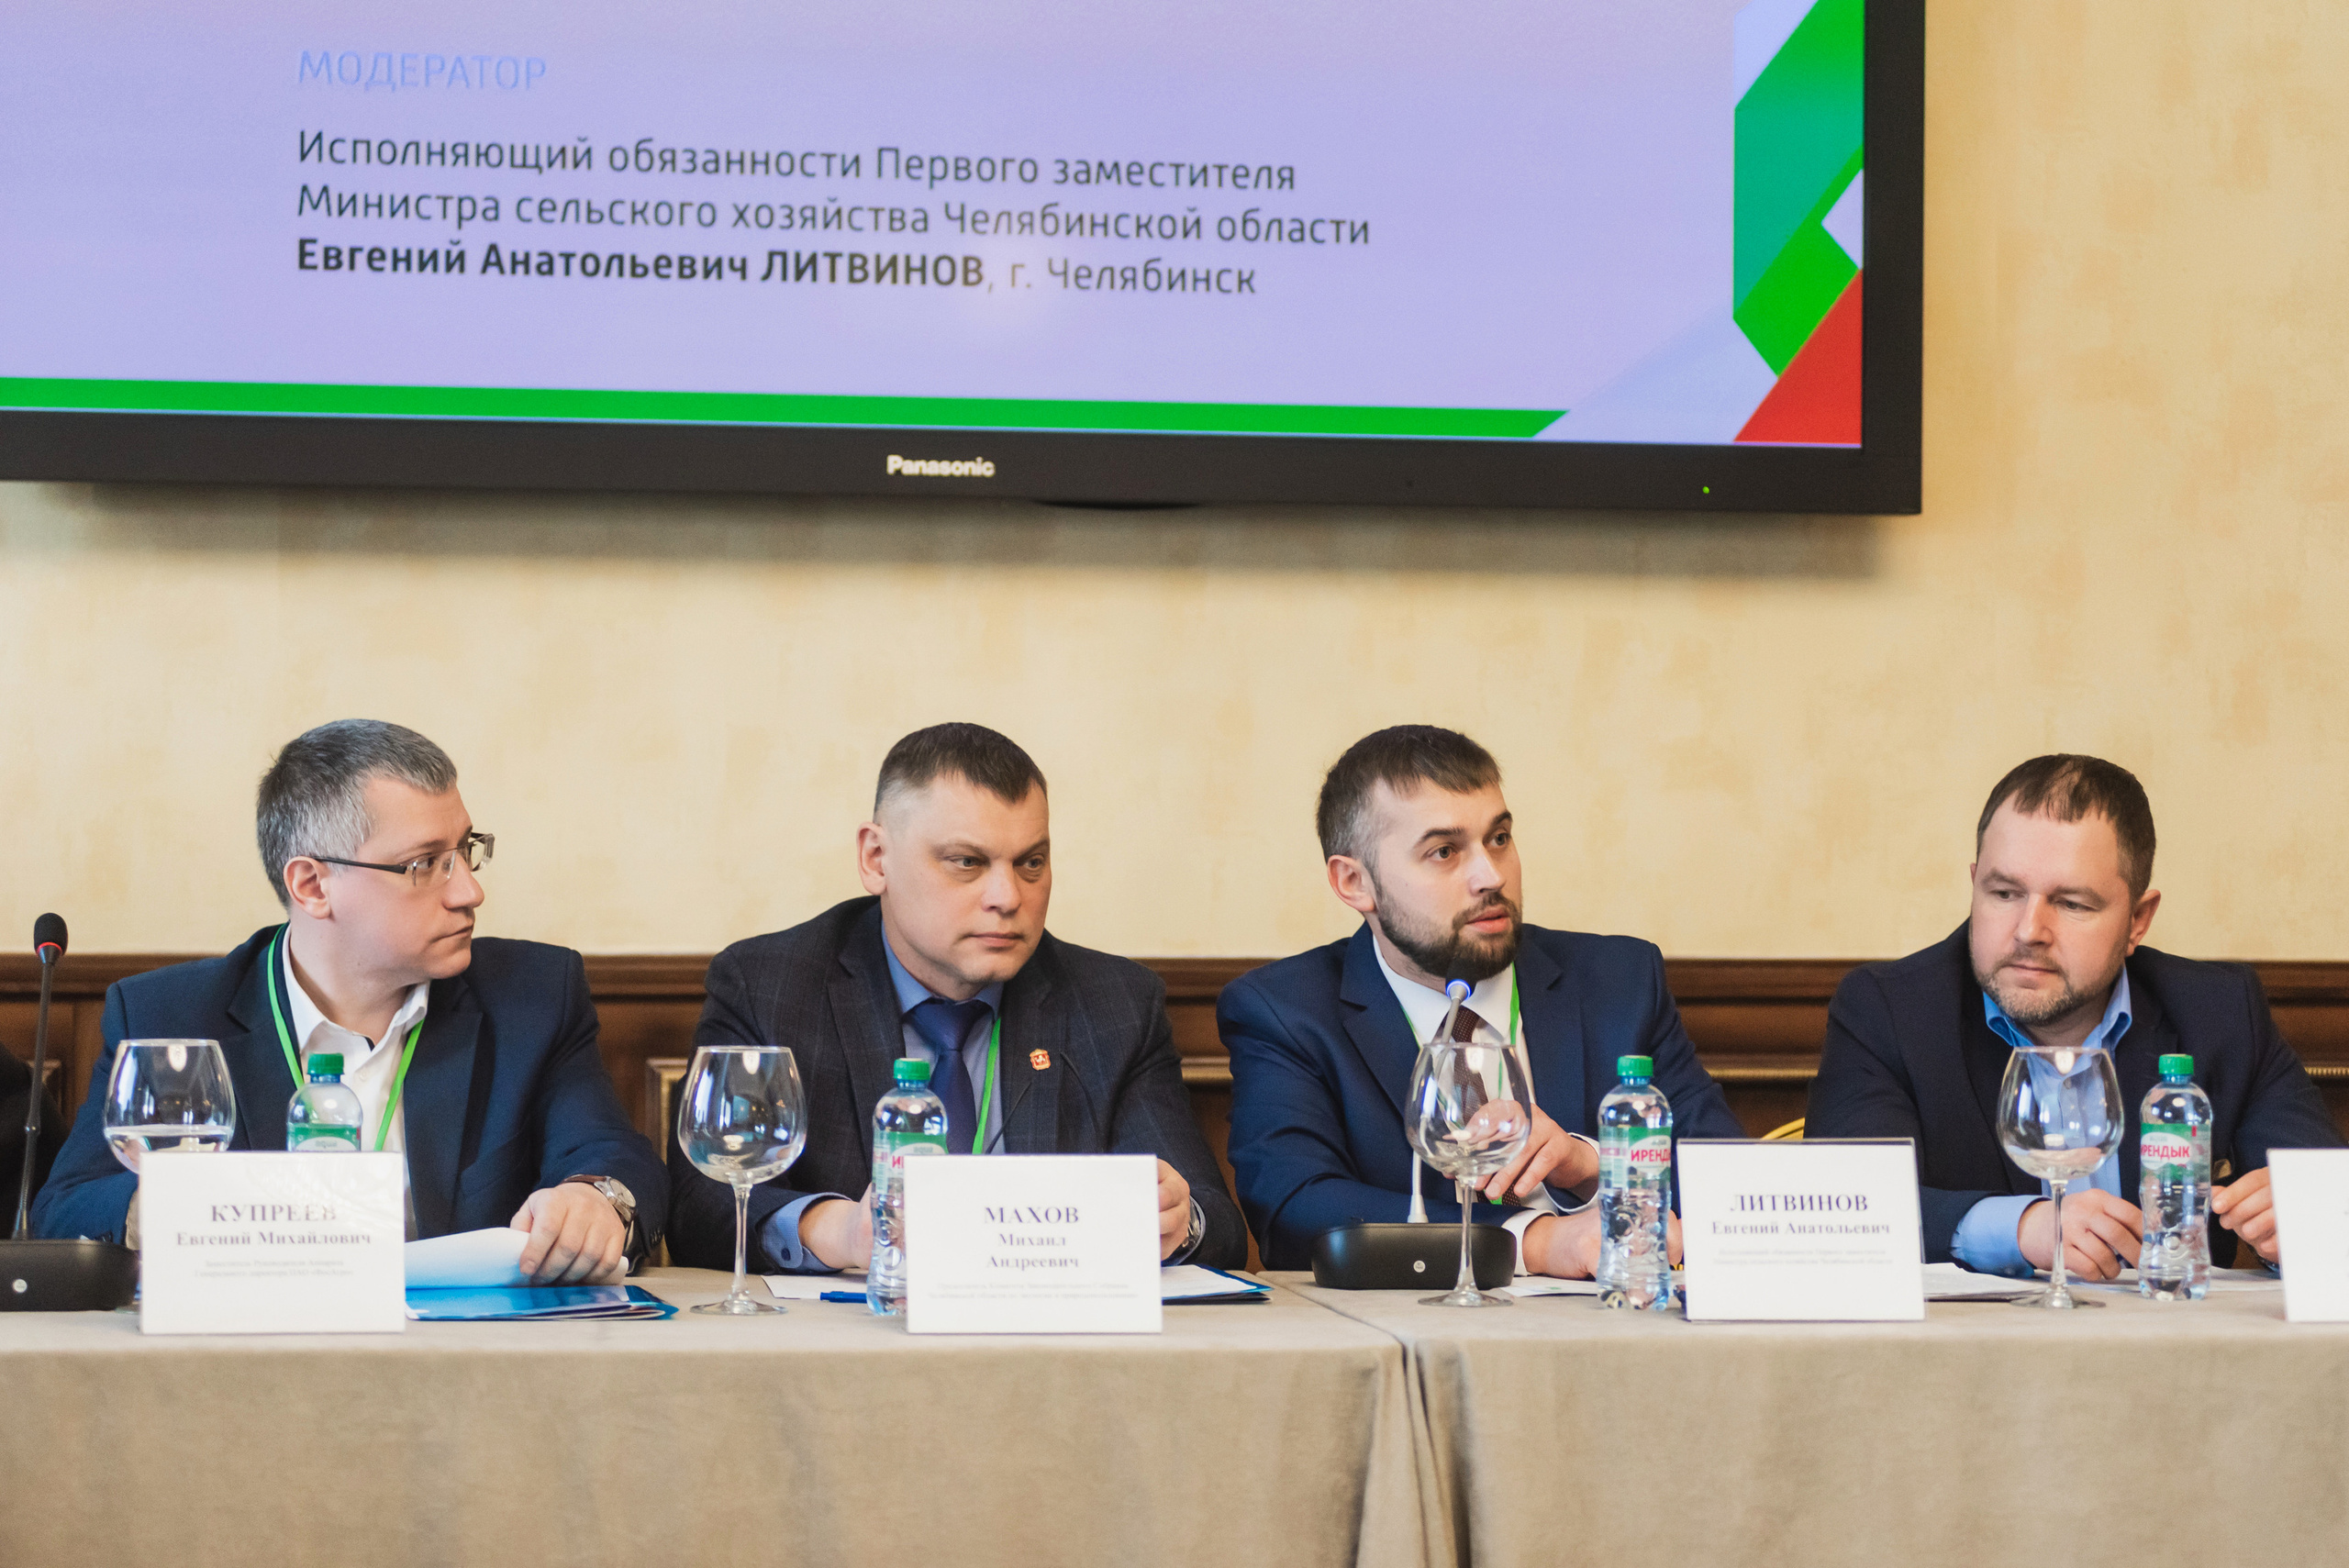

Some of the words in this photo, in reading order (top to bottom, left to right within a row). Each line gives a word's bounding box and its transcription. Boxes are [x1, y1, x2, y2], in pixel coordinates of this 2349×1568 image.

[298, 49, 547, 93] МОДЕРАТОР
[299, 129, 593, 174] Исполняющий
[607, 137, 862, 179] обязанности
[876, 146, 1040, 190] Первого
[1052, 158, 1296, 191] заместителя
[297, 183, 500, 231] Министра
[515, 196, 718, 228] сельского
[731, 196, 930, 233] хозяйства
[943, 201, 1202, 241] Челябинской
[1216, 206, 1370, 245] области
[297, 237, 466, 275] Евгений
[480, 242, 748, 282] Анатольевич
[760, 250, 994, 293] ЛИТВИНОВ,
[1010, 262, 1032, 289] г.
[1047, 257, 1256, 294] Челябинск
[886, 454, 996, 477] Panasonic
[1631, 1149, 1671, 1163] ИРЕНД
[2141, 1144, 2190, 1160] РЕНДЫК
[1730, 1194, 1868, 1212] ЛИТВИНОВ
[211, 1204, 337, 1223] КУПРЕЕВ
[985, 1207, 1080, 1224] МАХОВ
[1711, 1220, 1780, 1235] Евгений
[1786, 1221, 1890, 1235] Анатольевич
[176, 1230, 251, 1247] Евгений
[258, 1229, 372, 1246] Михайлович
[997, 1232, 1067, 1247] Михаил
[986, 1255, 1079, 1272] Андреевич
